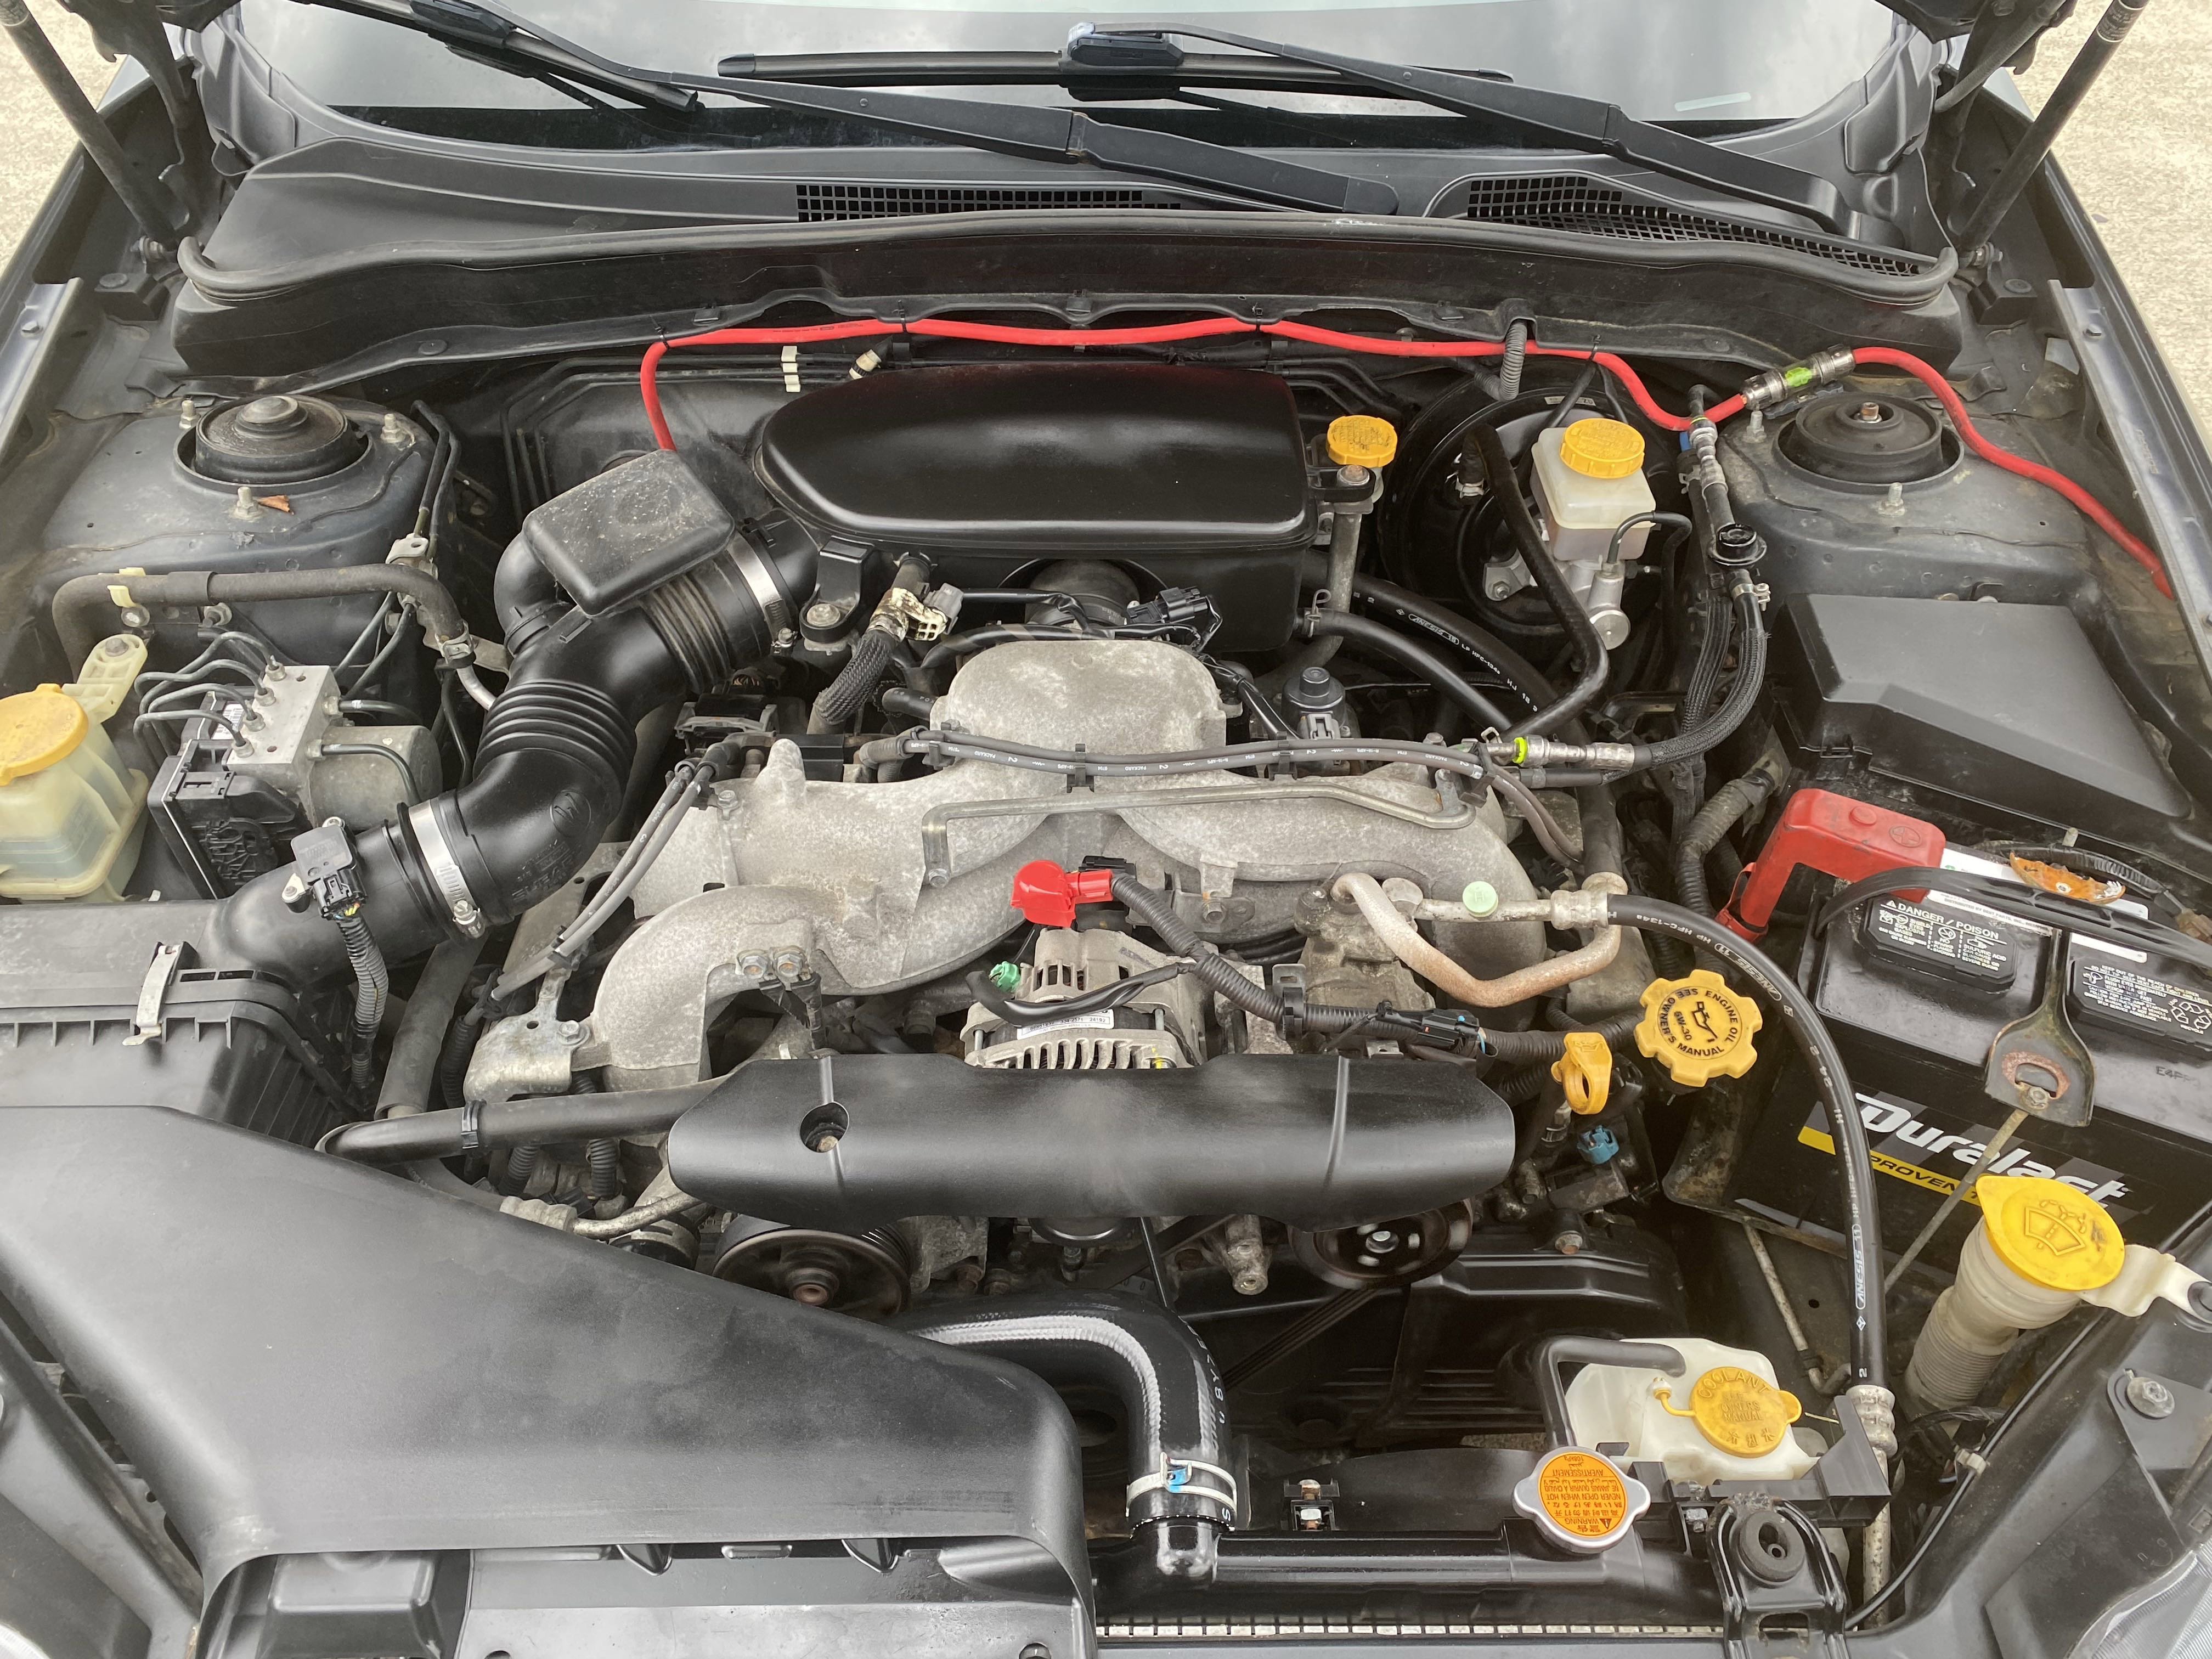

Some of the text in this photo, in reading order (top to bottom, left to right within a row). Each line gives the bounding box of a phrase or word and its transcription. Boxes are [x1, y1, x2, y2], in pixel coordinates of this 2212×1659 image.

[974, 750, 997, 759] PACKARD
[1425, 753, 1448, 761] PACKARD
[652, 802, 667, 823] PACKARD
[1636, 914, 1693, 935] HFC-134a
[1898, 902, 1944, 924] DANGER
[1956, 921, 2000, 940] POISON
[1909, 923, 1924, 931] EYES
[1910, 918, 1931, 928] SHIELD
[1894, 922, 1926, 936] EXPLOSIVE
[1894, 927, 1913, 937] GASES
[1696, 934, 1712, 944] HP
[1963, 944, 2007, 962] SULFURIC ACID
[1734, 958, 1778, 997] ANESIS
[1660, 988, 1725, 1057] SEE OWNER'S MANUAL
[1705, 990, 1739, 1043] ENGINE OIL
[1854, 1228, 1861, 1242] 11
[1854, 1249, 1864, 1304] ANESIS
[1698, 1368, 1771, 1400] COOLANT
[1723, 1412, 1764, 1423] MANUAL
[1552, 1469, 1604, 1477] AVERTISSEMENT
